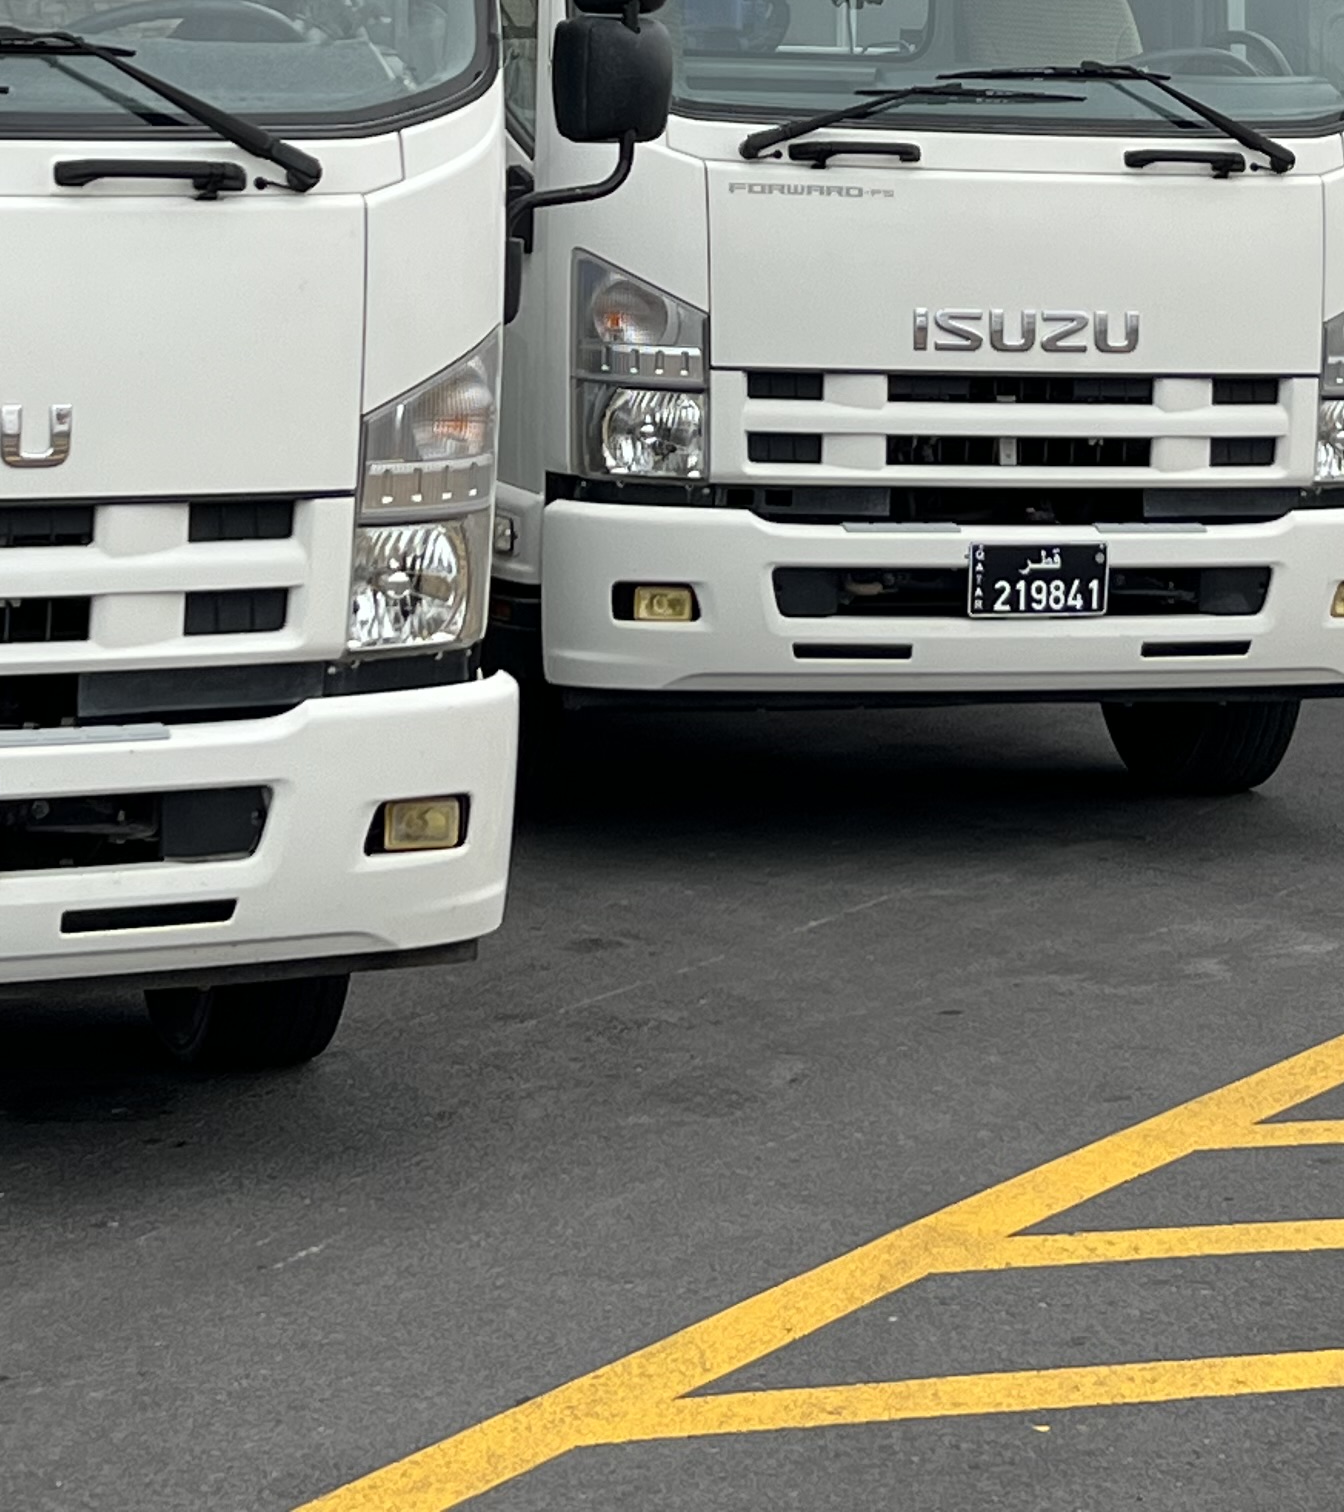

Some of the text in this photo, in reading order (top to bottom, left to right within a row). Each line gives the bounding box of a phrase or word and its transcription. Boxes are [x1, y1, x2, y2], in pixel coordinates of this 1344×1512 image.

[913, 306, 1141, 354] ISUZU
[974, 549, 985, 610] QATAR
[1018, 548, 1062, 575] قطر
[993, 578, 1100, 611] 219841
